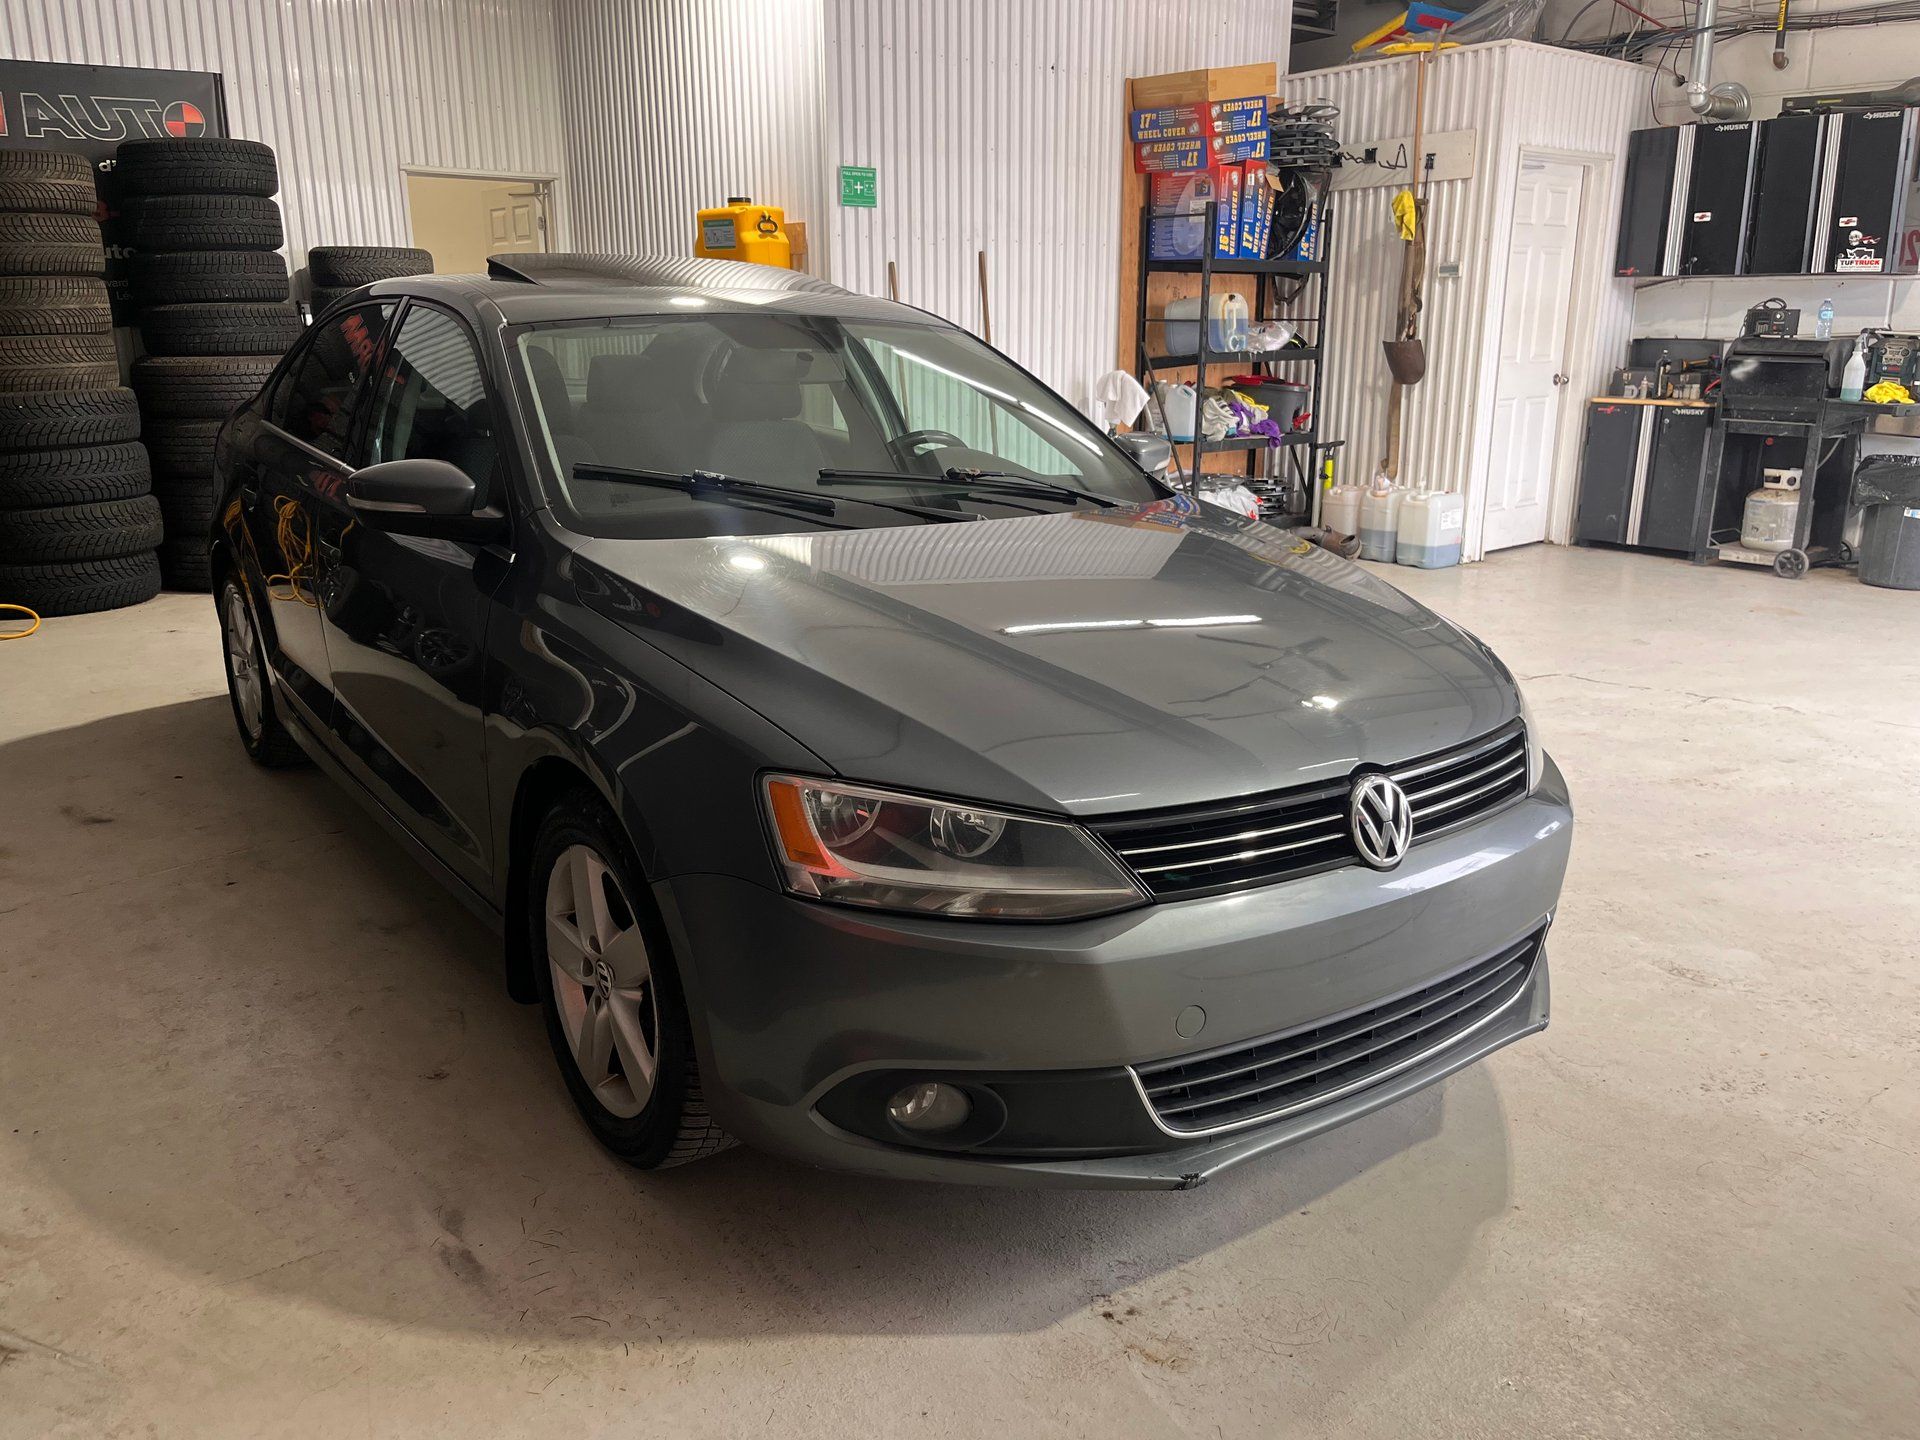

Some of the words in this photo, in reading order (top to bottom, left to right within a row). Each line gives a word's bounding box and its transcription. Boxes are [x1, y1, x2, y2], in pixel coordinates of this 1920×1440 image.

[1223, 102, 1242, 112] COVER
[1243, 99, 1263, 110] WHEEL
[1872, 111, 1900, 119] HUSKY
[1724, 123, 1749, 131] HUSKY
[1138, 129, 1161, 140] WHEEL
[1163, 127, 1186, 137] COVER
[1225, 133, 1246, 144] COVER
[1246, 130, 1267, 141] WHEEL
[1153, 143, 1175, 152] COVER
[1178, 140, 1201, 149] WHEEL
[1231, 190, 1239, 221] COVER
[1260, 228, 1269, 260] WHEEL
[1265, 195, 1275, 226] COVER
[1253, 221, 1261, 253] WHEEL
[1680, 408, 1705, 416] HUSKY
